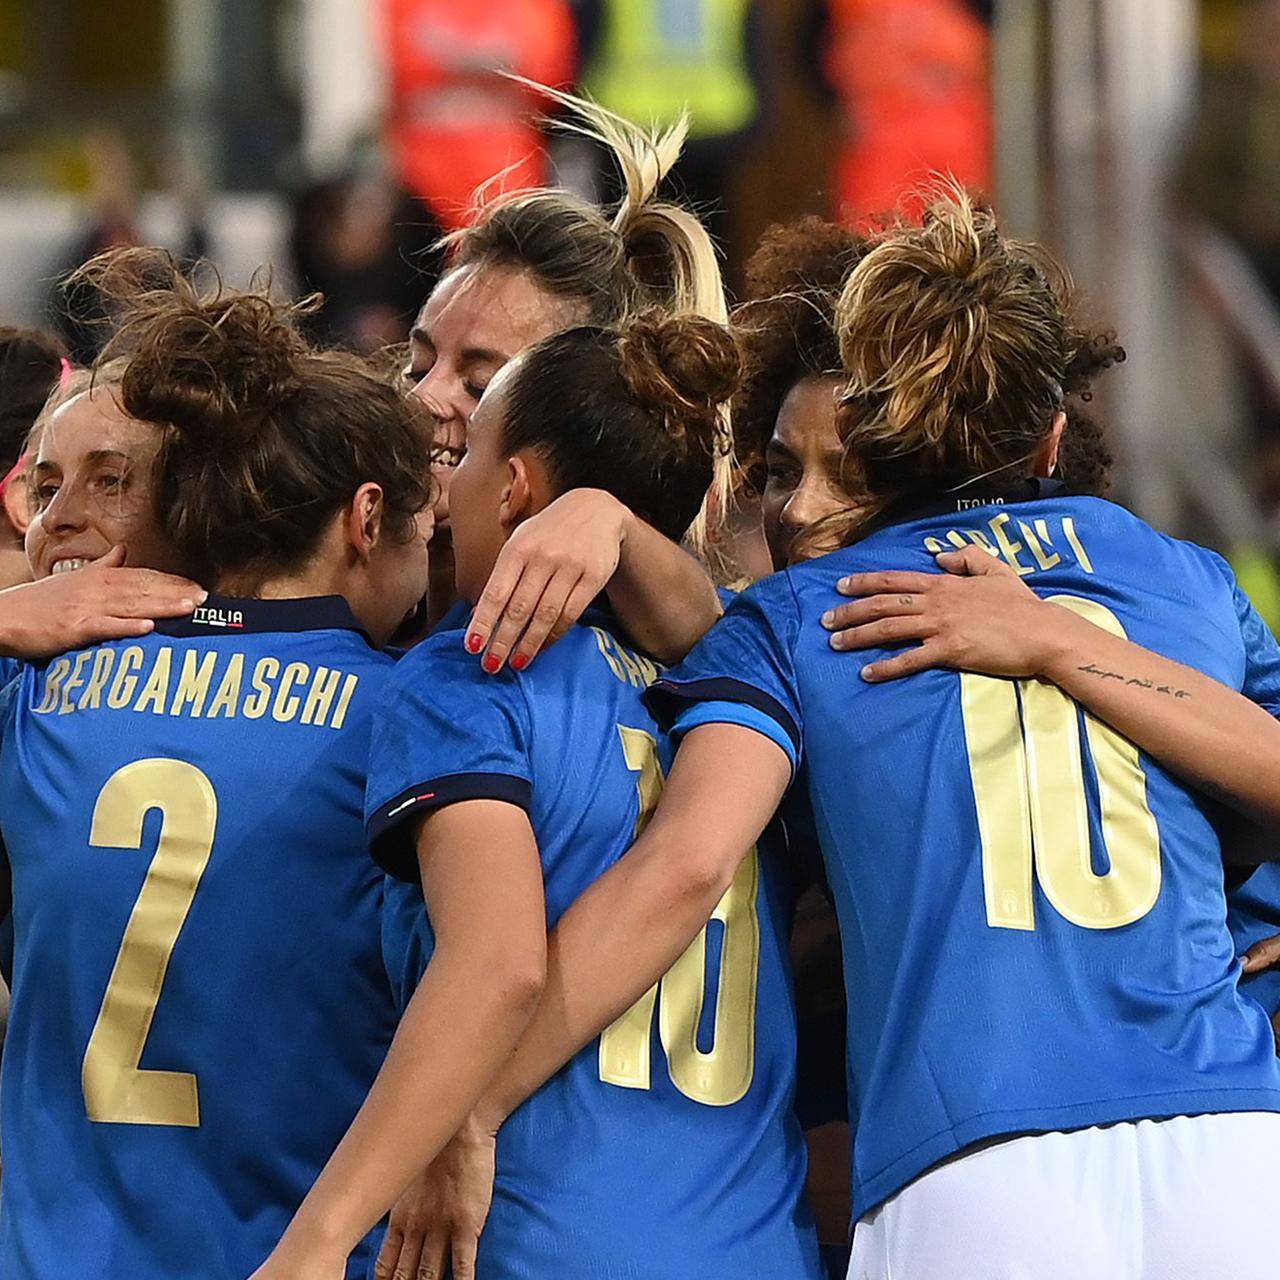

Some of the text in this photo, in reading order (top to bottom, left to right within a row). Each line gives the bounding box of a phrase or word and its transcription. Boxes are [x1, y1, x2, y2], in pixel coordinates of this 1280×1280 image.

[32, 645, 359, 730] BERGAMASCHI
[193, 607, 243, 625] ITALIA
[959, 594, 1162, 931] 10
[81, 757, 218, 1128] 2
